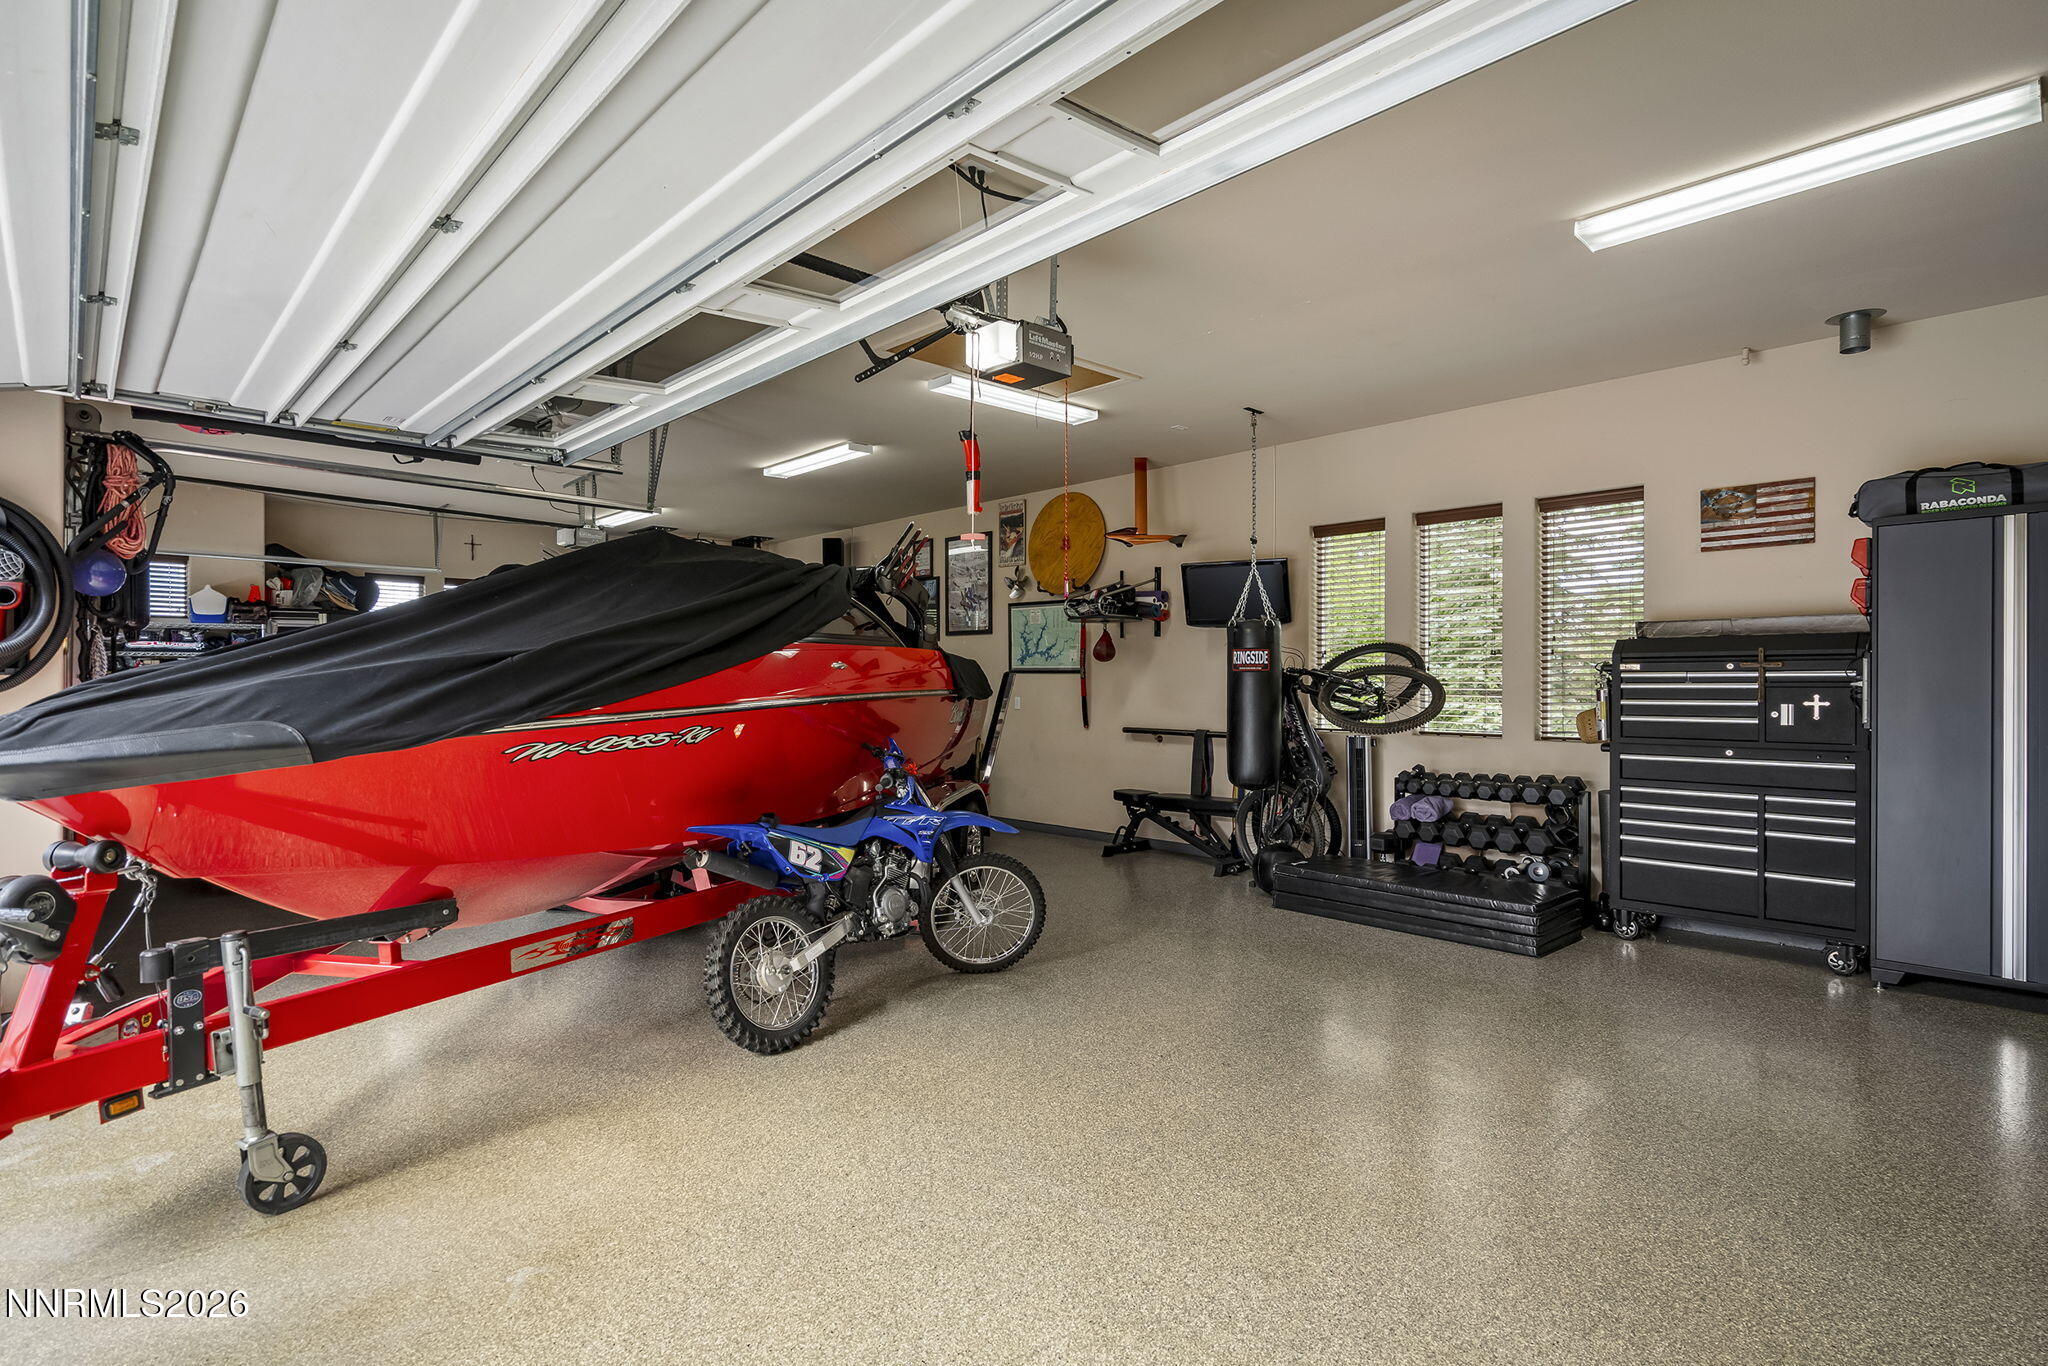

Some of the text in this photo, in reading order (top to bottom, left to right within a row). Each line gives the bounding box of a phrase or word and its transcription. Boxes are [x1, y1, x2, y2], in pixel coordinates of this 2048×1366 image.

[1920, 494, 2007, 511] RABACONDA
[1232, 651, 1269, 664] RINGSIDE
[789, 840, 823, 873] 62
